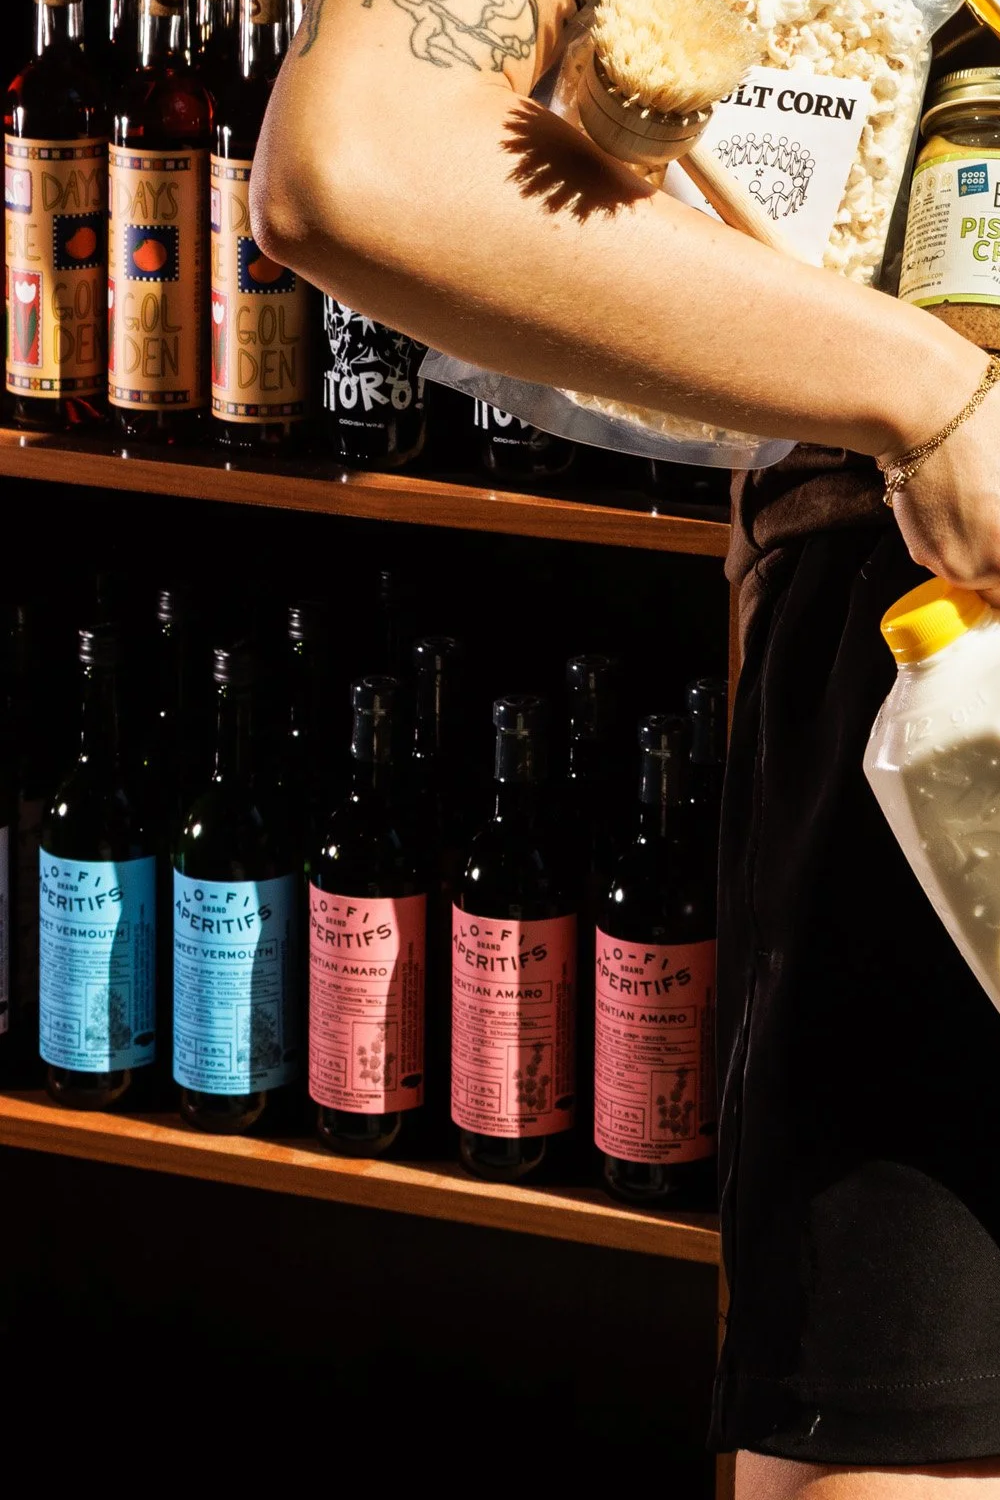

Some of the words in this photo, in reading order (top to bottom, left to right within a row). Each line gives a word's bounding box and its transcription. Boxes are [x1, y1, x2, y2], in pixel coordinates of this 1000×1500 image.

[777, 89, 858, 121] CORN
[961, 171, 986, 179] GOOD
[118, 180, 179, 221] DAYS
[123, 291, 182, 334] GOL
[236, 304, 300, 346] GOL
[123, 335, 179, 378] DEN
[237, 347, 296, 392] DEN
[57, 882, 79, 892] BRAND
[40, 881, 125, 913] PERITIFS
[202, 904, 227, 914] BRAND
[175, 900, 272, 934] APERITIFS
[325, 916, 347, 927] BRAND
[56, 924, 125, 939] VERMOUTH
[311, 918, 392, 948] PERITIFS
[201, 947, 273, 960] VERMOUTH
[453, 934, 548, 972] APERITIFS
[476, 941, 501, 951] BRAND
[342, 966, 388, 977] AMARO
[596, 957, 692, 996] APERITIFS
[620, 965, 644, 975] BRAND
[496, 989, 543, 999] AMARO
[639, 1014, 687, 1024] AMARO
[470, 1097, 486, 1106] 750
